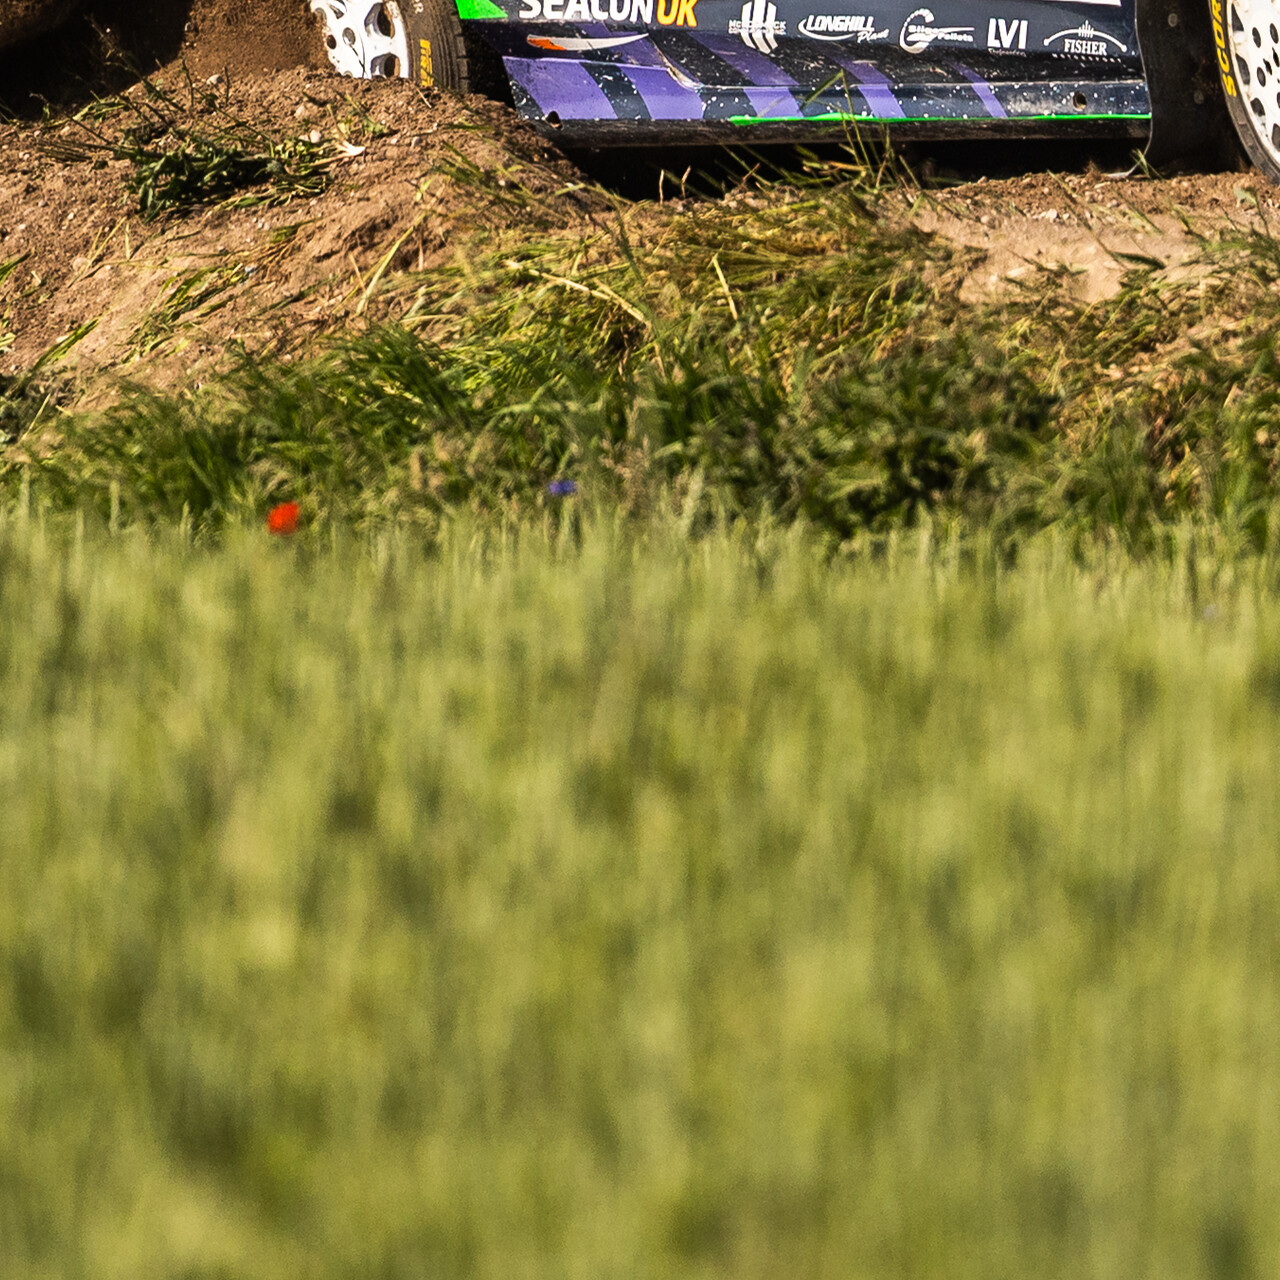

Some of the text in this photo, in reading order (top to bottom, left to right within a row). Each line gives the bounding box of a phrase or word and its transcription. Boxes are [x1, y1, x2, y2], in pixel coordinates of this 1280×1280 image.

[806, 14, 876, 33] LONGHILL
[856, 29, 890, 44] Plant
[937, 32, 975, 43] Pellets
[986, 17, 1030, 50] LVI
[1063, 38, 1108, 56] FISHER
